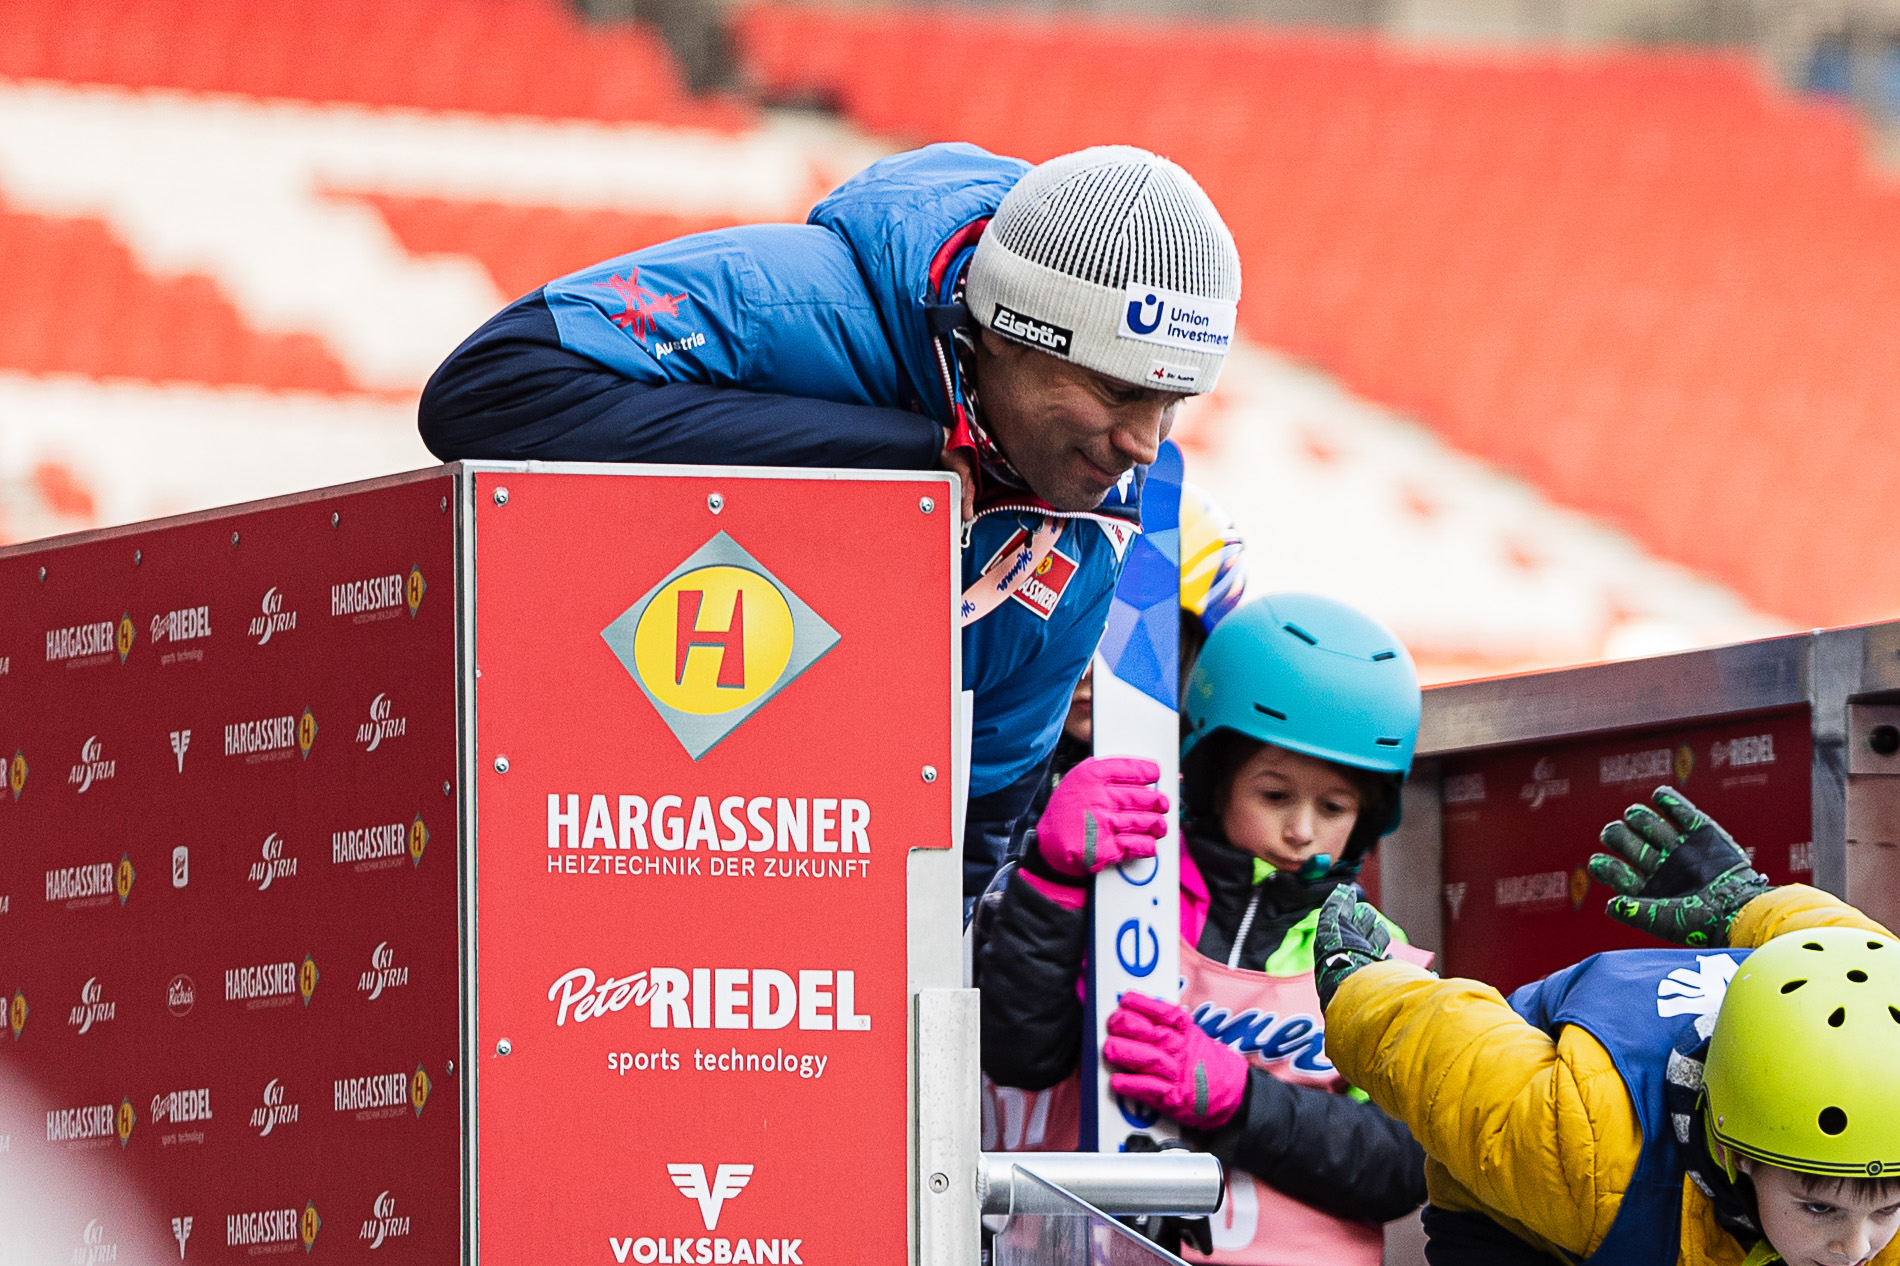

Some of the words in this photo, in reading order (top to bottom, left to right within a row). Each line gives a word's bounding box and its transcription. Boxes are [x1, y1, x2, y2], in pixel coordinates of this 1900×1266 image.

[993, 309, 1067, 349] Eisbär
[1167, 324, 1230, 347] Investment
[1171, 307, 1209, 327] Union
[655, 332, 706, 360] Austria
[331, 574, 403, 616] HARGASSNER
[1018, 576, 1059, 613] ASSNER
[46, 621, 114, 662] HARGASSNER
[169, 606, 212, 643] RIEDEL
[225, 716, 295, 756] HARGASSNER
[547, 793, 871, 854] HARGASSNER
[332, 824, 405, 864] HARGASSNER
[46, 864, 113, 901] HARGASSNER
[547, 855, 702, 876] HEIZTECHNIK
[709, 858, 756, 876] DER
[763, 857, 871, 879] ZUKUNFT
[225, 963, 296, 1000] HARGASSNER
[548, 967, 659, 1027] Peter
[650, 967, 872, 1031] RIEDEL
[607, 1048, 680, 1076] sports
[693, 1047, 828, 1079] technology
[169, 1088, 212, 1124] RIEDEL
[334, 1073, 407, 1111] HARGASSNER
[46, 1105, 114, 1141] HARGASSNER
[227, 1209, 297, 1246] HARGASSNER
[609, 1237, 804, 1265] VOLKSBANK
